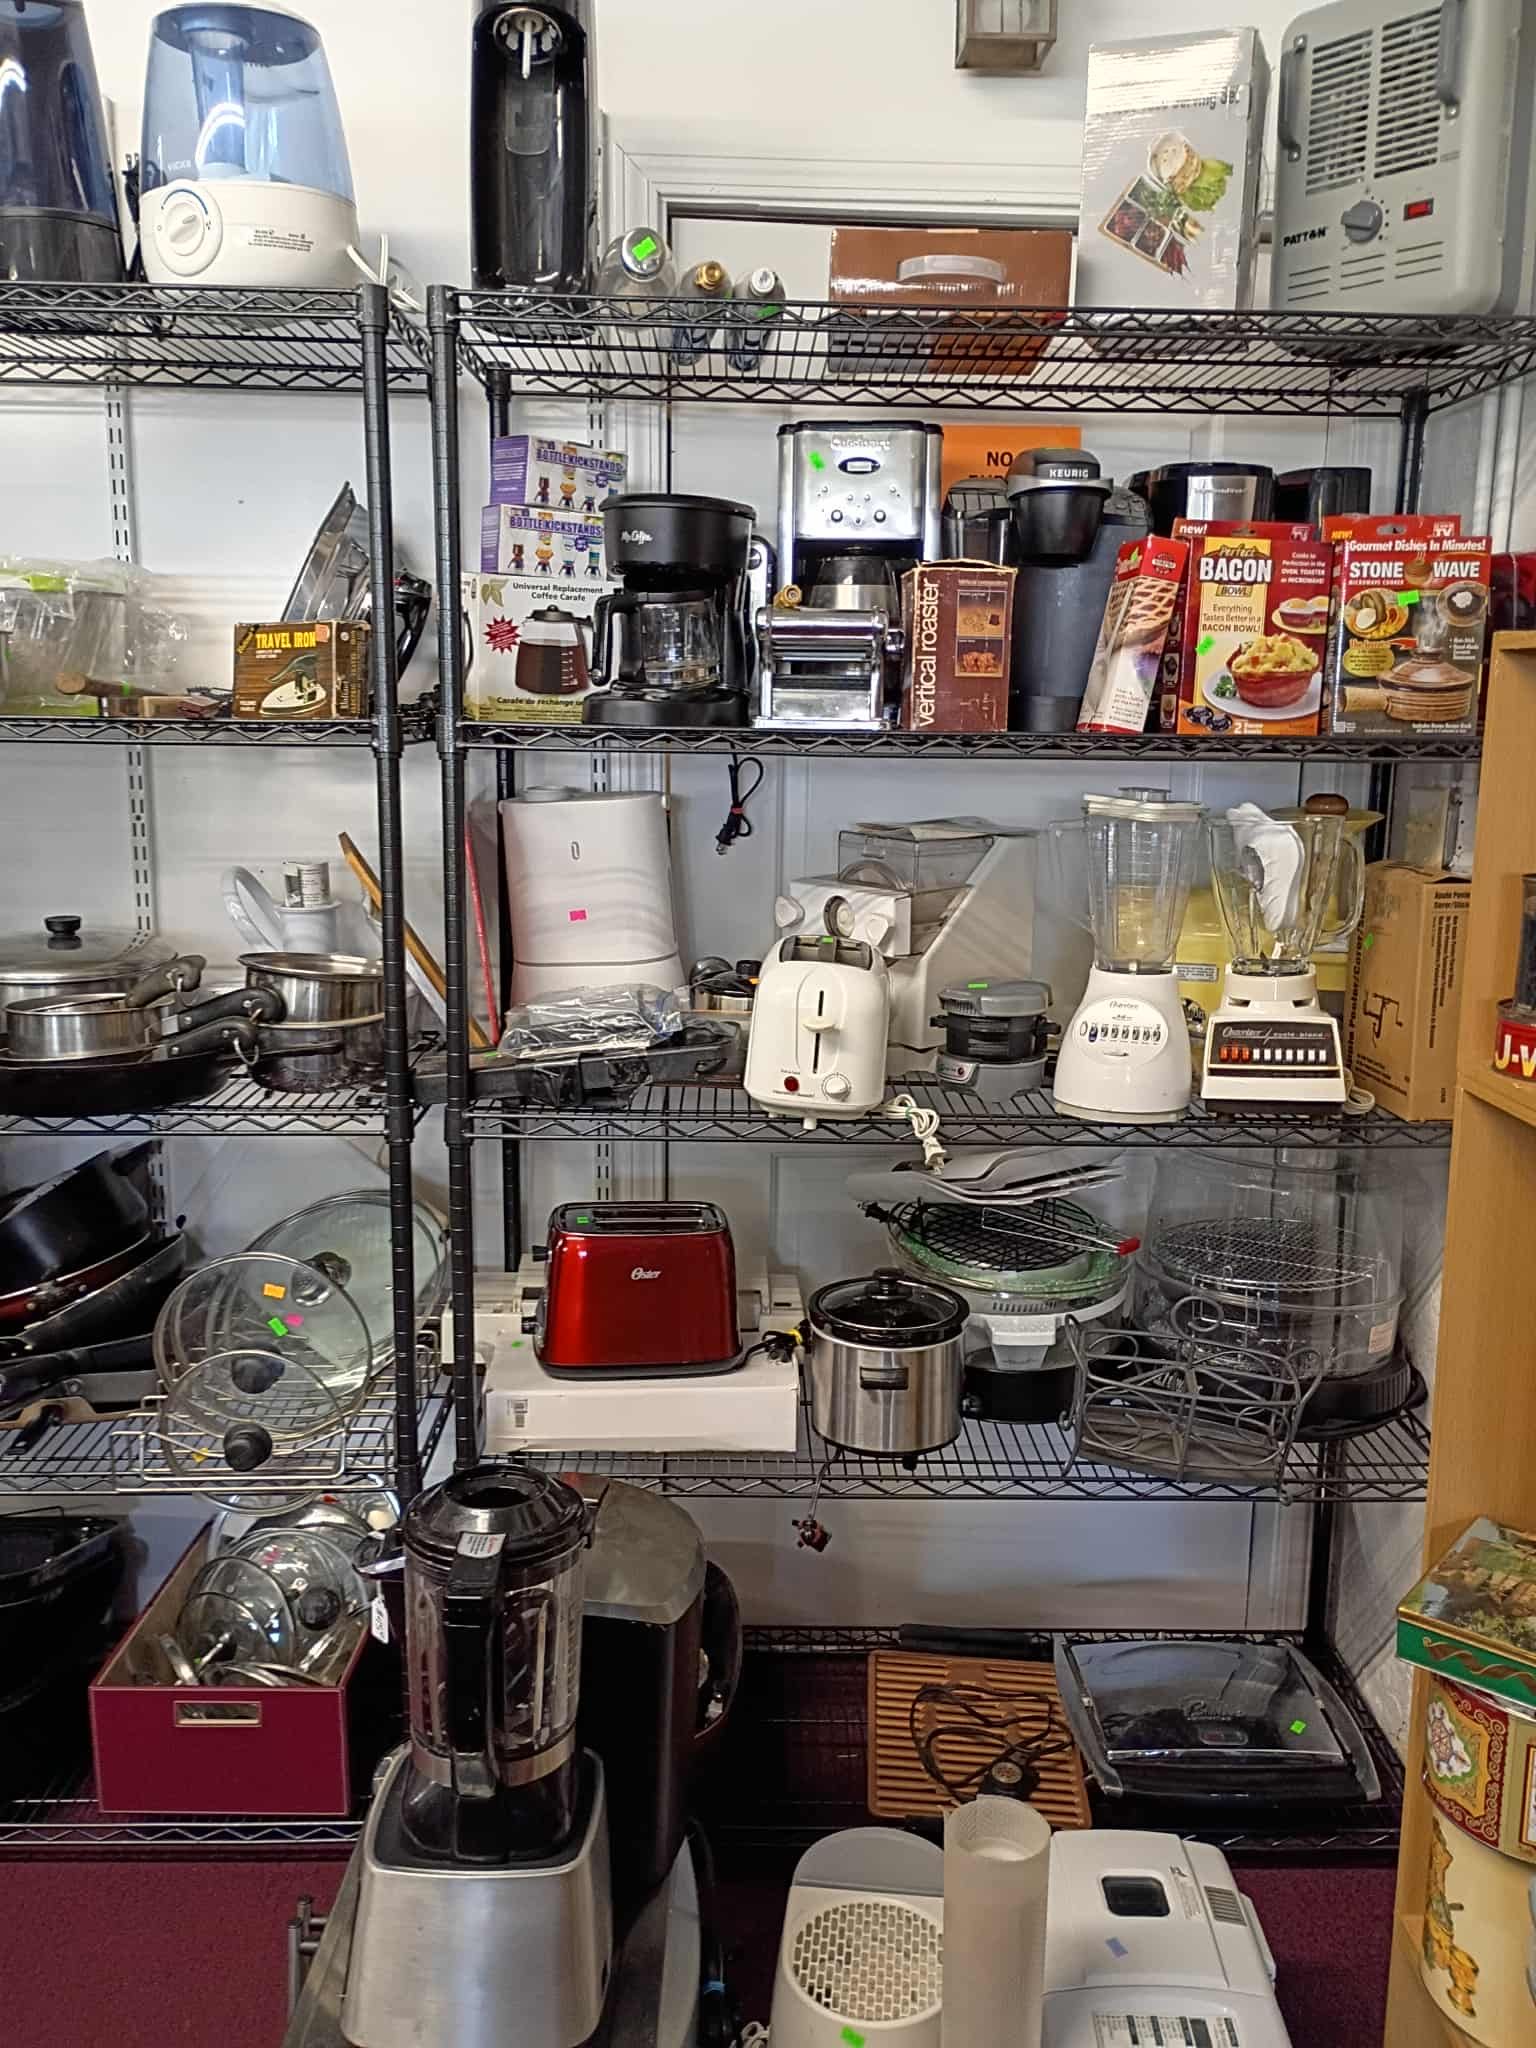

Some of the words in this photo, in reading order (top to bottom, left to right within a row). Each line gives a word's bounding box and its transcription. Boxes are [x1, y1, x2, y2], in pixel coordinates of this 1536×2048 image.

[1283, 227, 1328, 247] PATTON
[986, 451, 1013, 467] NO
[1049, 468, 1089, 478] KEURIG
[1179, 523, 1207, 534] new!
[1220, 544, 1256, 557] Perfect
[1349, 541, 1393, 552] Gourmet
[1394, 539, 1427, 552] Dishes
[1430, 540, 1439, 551] In
[1442, 539, 1486, 551] Minutes!
[1200, 557, 1272, 582] BACON
[1349, 561, 1404, 578] STONE
[1432, 561, 1480, 578] WAVE
[513, 582, 551, 592] Universal
[552, 584, 603, 594] Replacement
[1221, 586, 1249, 596] BOWL
[531, 591, 559, 600] Coffee
[560, 592, 586, 601] Carafe
[917, 577, 940, 652] roaster
[1213, 603, 1252, 614] Everything
[1202, 623, 1231, 632] BACON
[1234, 624, 1260, 633] BOWL!
[256, 632, 292, 648] TRAVEL
[293, 631, 316, 648] IRON
[915, 655, 936, 727] vertical
[631, 1266, 662, 1280] Oster
